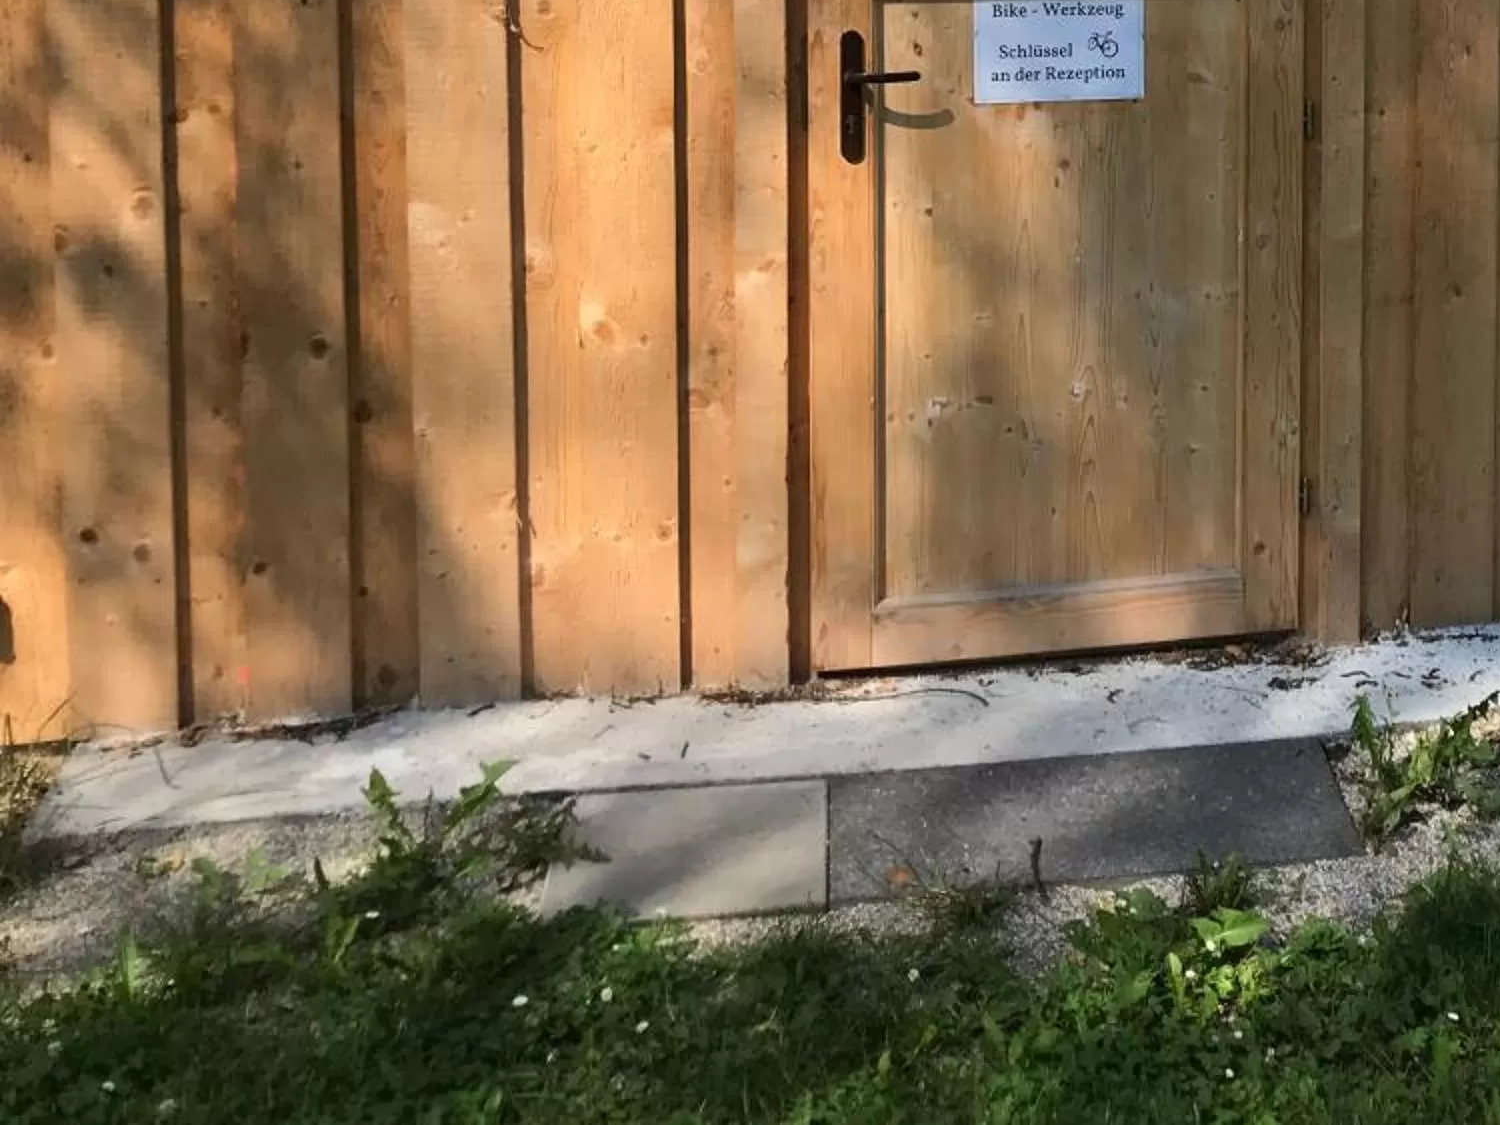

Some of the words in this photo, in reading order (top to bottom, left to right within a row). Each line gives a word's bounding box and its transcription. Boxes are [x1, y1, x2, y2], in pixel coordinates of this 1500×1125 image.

[992, 2, 1028, 18] Bike
[1042, 1, 1125, 19] Werkzeug
[998, 42, 1073, 59] Schlüssel
[991, 70, 1011, 82] an
[1015, 67, 1041, 82] der
[1045, 65, 1125, 84] Rezeption
